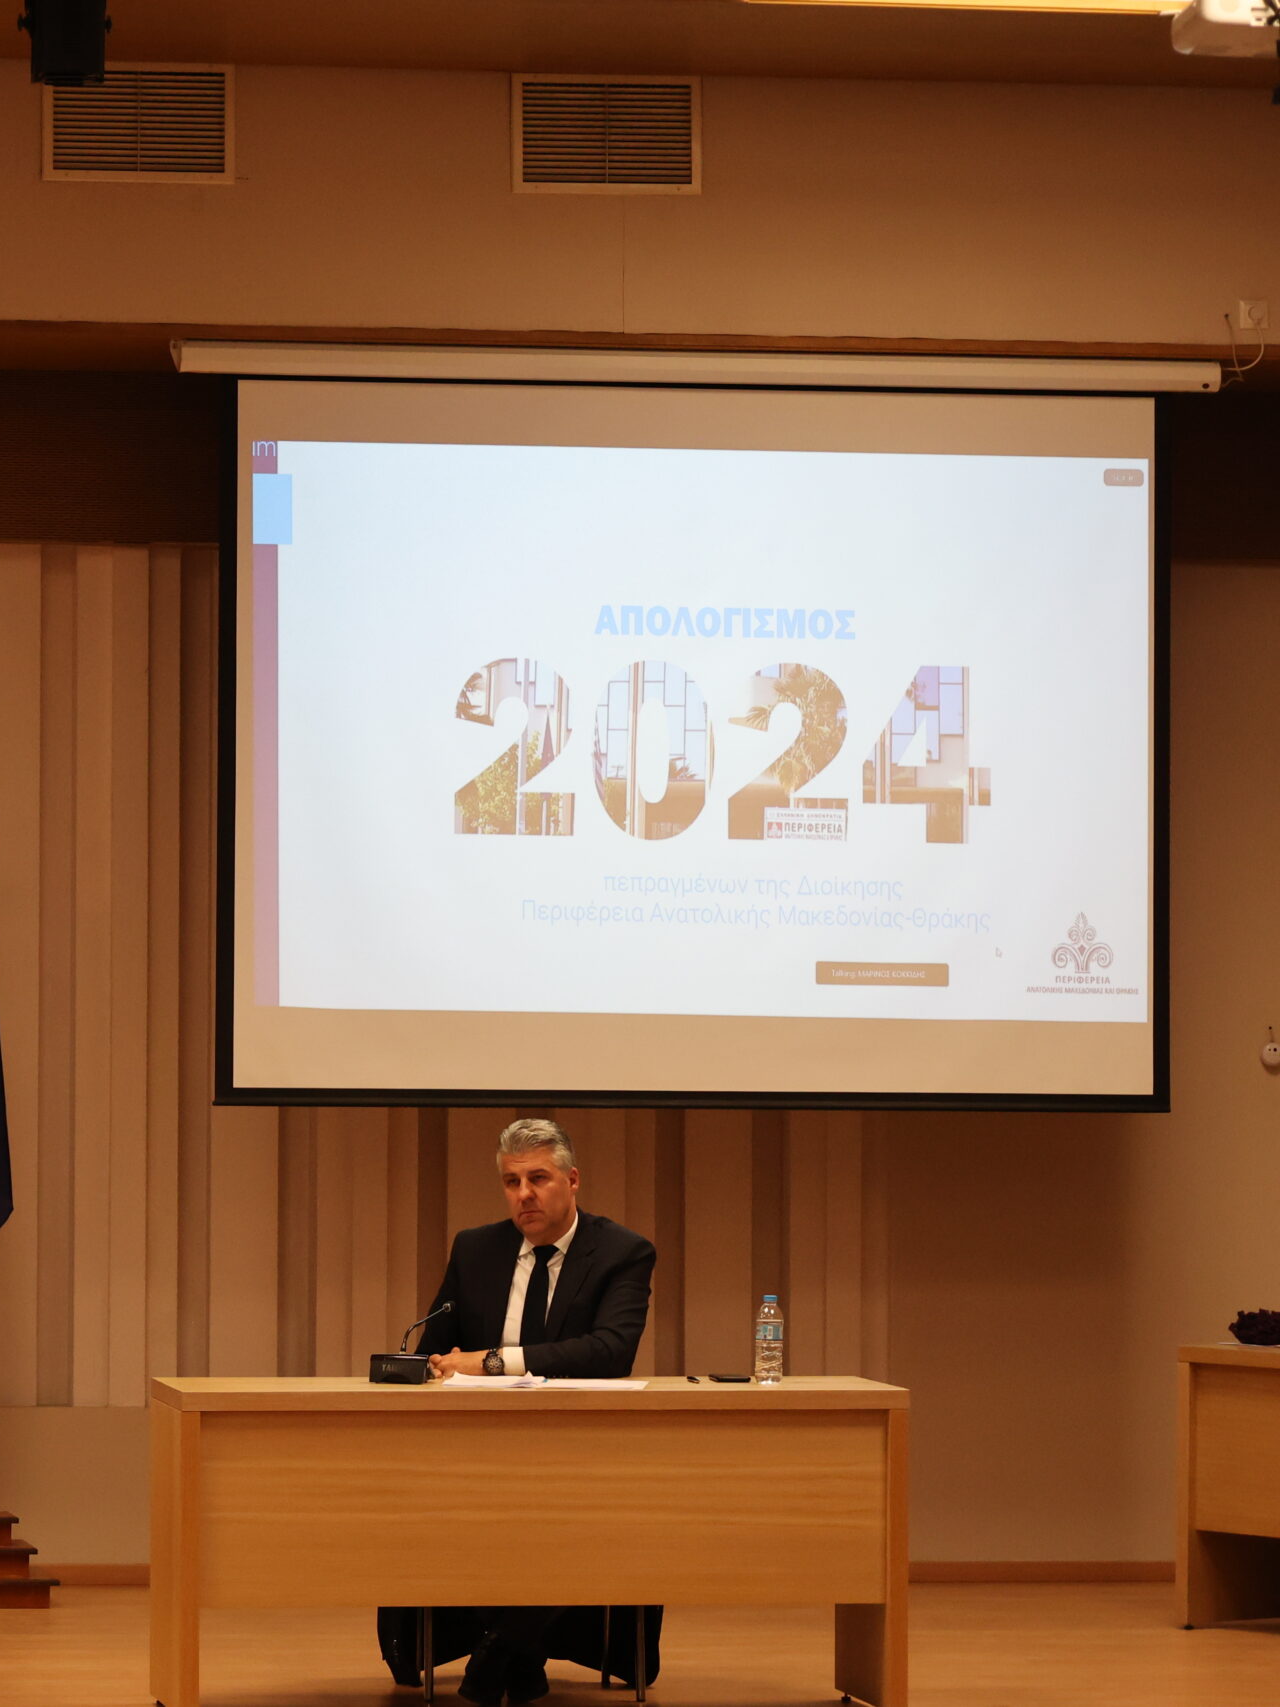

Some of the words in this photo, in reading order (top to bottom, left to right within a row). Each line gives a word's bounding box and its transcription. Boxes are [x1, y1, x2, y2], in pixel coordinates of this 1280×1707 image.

[593, 604, 857, 640] ΑΠΟΛΟΓΙΣΜΟΣ
[454, 657, 992, 844] 2024
[784, 822, 843, 834] ΠΕΡΙΦΕΡΕΙΑ
[603, 873, 748, 897] πεπραγμένων
[754, 877, 791, 900] της
[797, 875, 904, 901] Διοίκησης
[521, 899, 645, 928] Περιφέρεια
[649, 902, 772, 929] Ανατολικής
[778, 904, 991, 933] Μακεδονίας-Θράκης
[1055, 975, 1111, 985] ΠΕΡΙΦΕΡΕΙΑ
